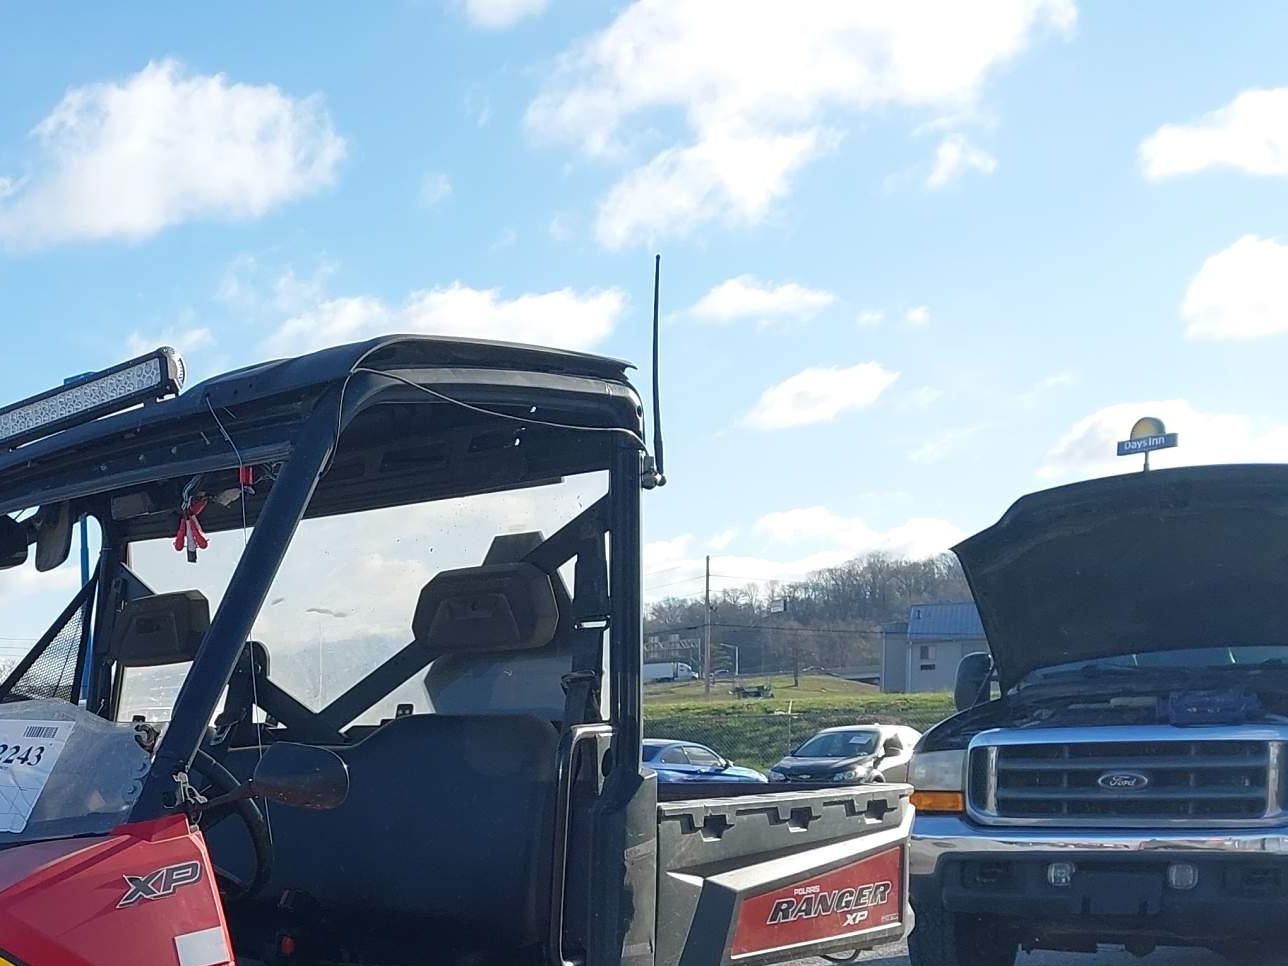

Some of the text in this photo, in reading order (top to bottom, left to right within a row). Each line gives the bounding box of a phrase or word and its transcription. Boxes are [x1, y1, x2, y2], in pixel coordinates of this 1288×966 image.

[1124, 436, 1165, 450] Days Inn
[1109, 775, 1137, 786] Ford
[115, 860, 202, 909] XP
[793, 885, 820, 896] POLARIS
[766, 881, 892, 925] RANGER
[843, 911, 868, 927] XP
